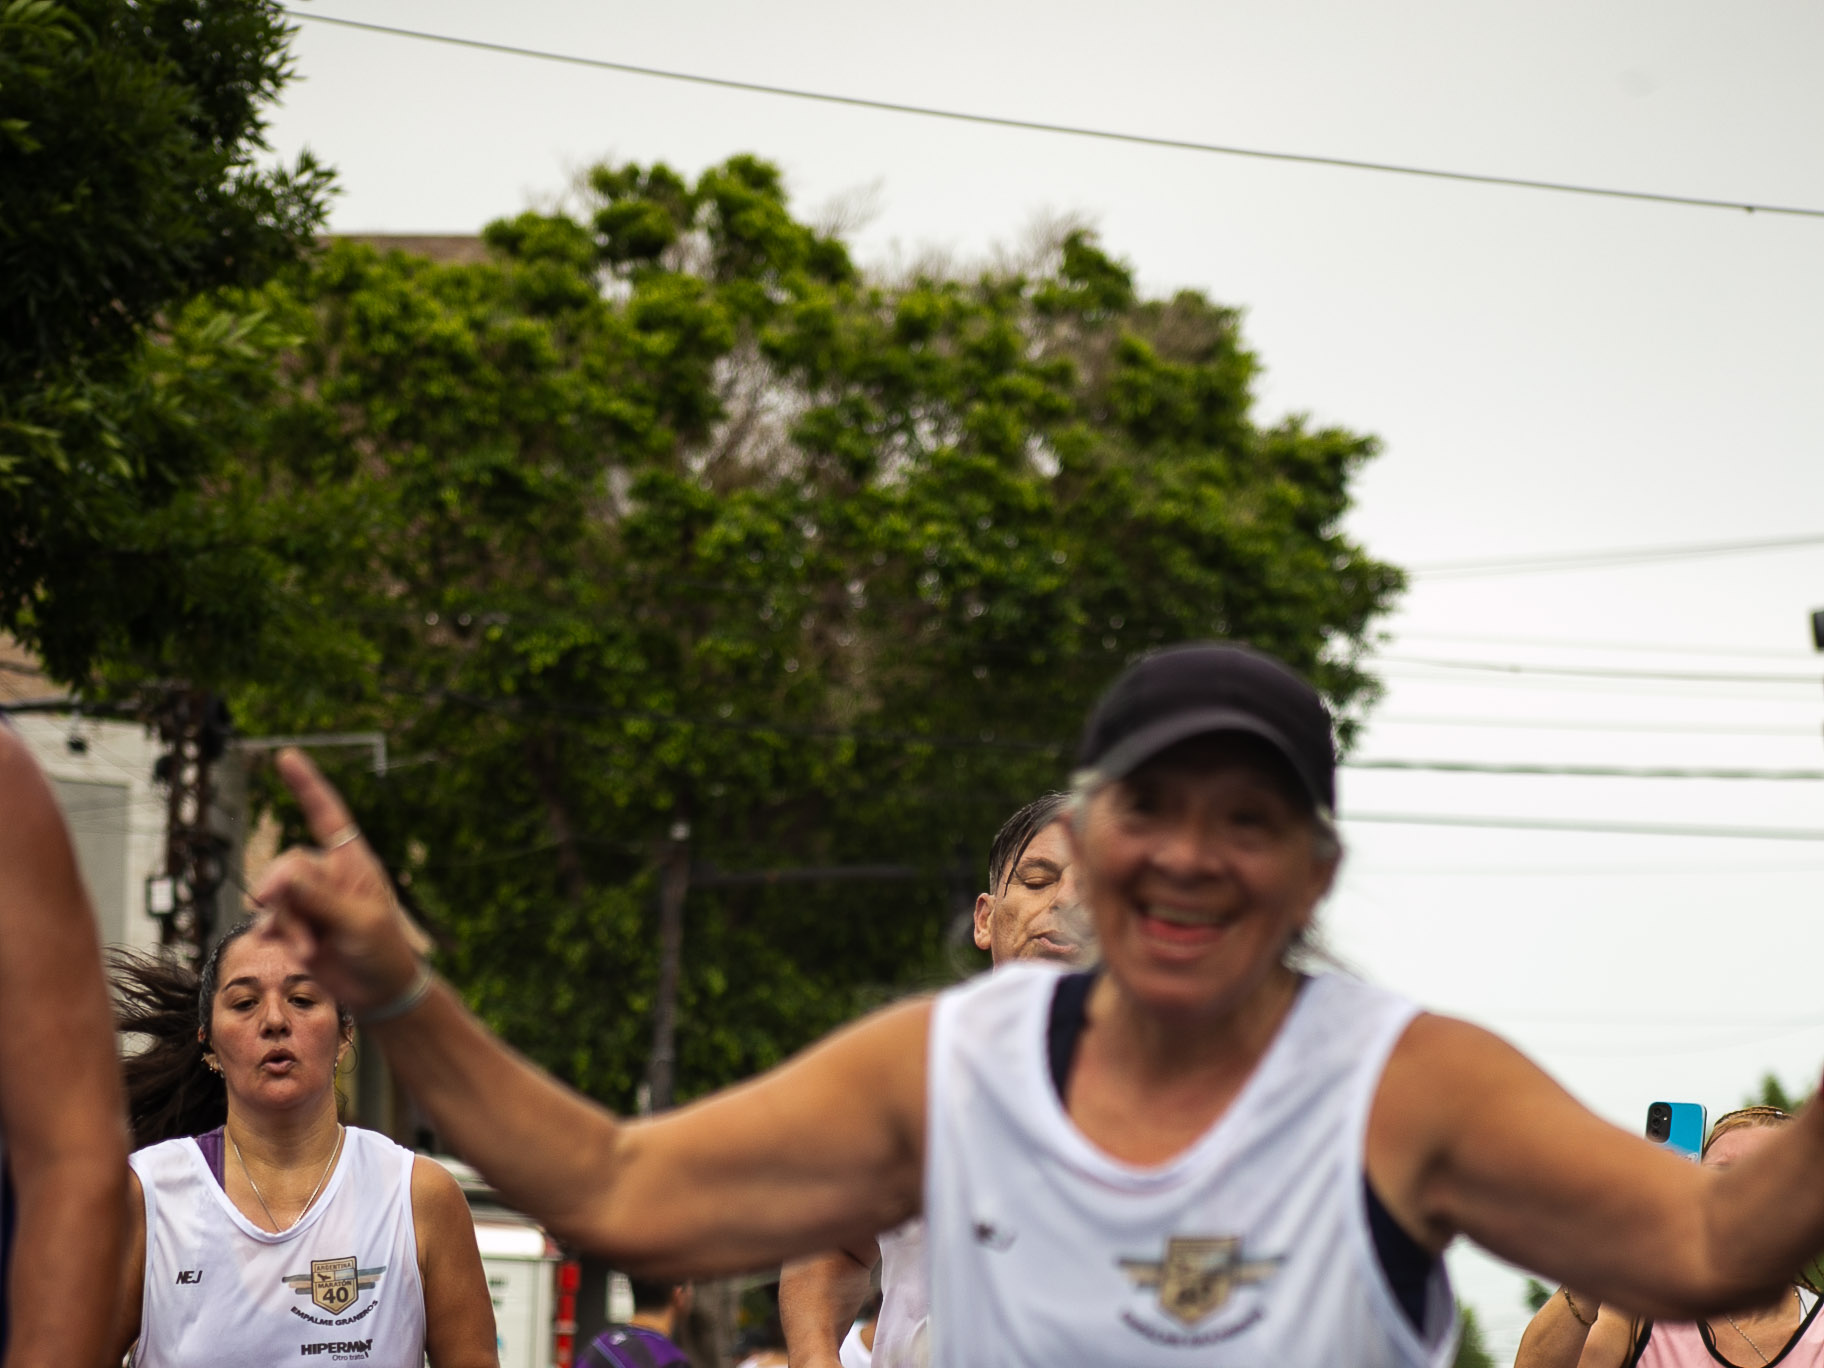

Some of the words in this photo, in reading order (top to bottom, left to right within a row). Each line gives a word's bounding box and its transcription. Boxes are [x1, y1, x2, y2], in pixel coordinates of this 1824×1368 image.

[317, 1263, 351, 1271] ARGENTINA
[176, 1270, 203, 1284] NEJ
[318, 1280, 352, 1288] MARATÓN
[323, 1287, 349, 1303] 40
[290, 1306, 334, 1326] EMPALME
[335, 1300, 378, 1326] GRANEROS
